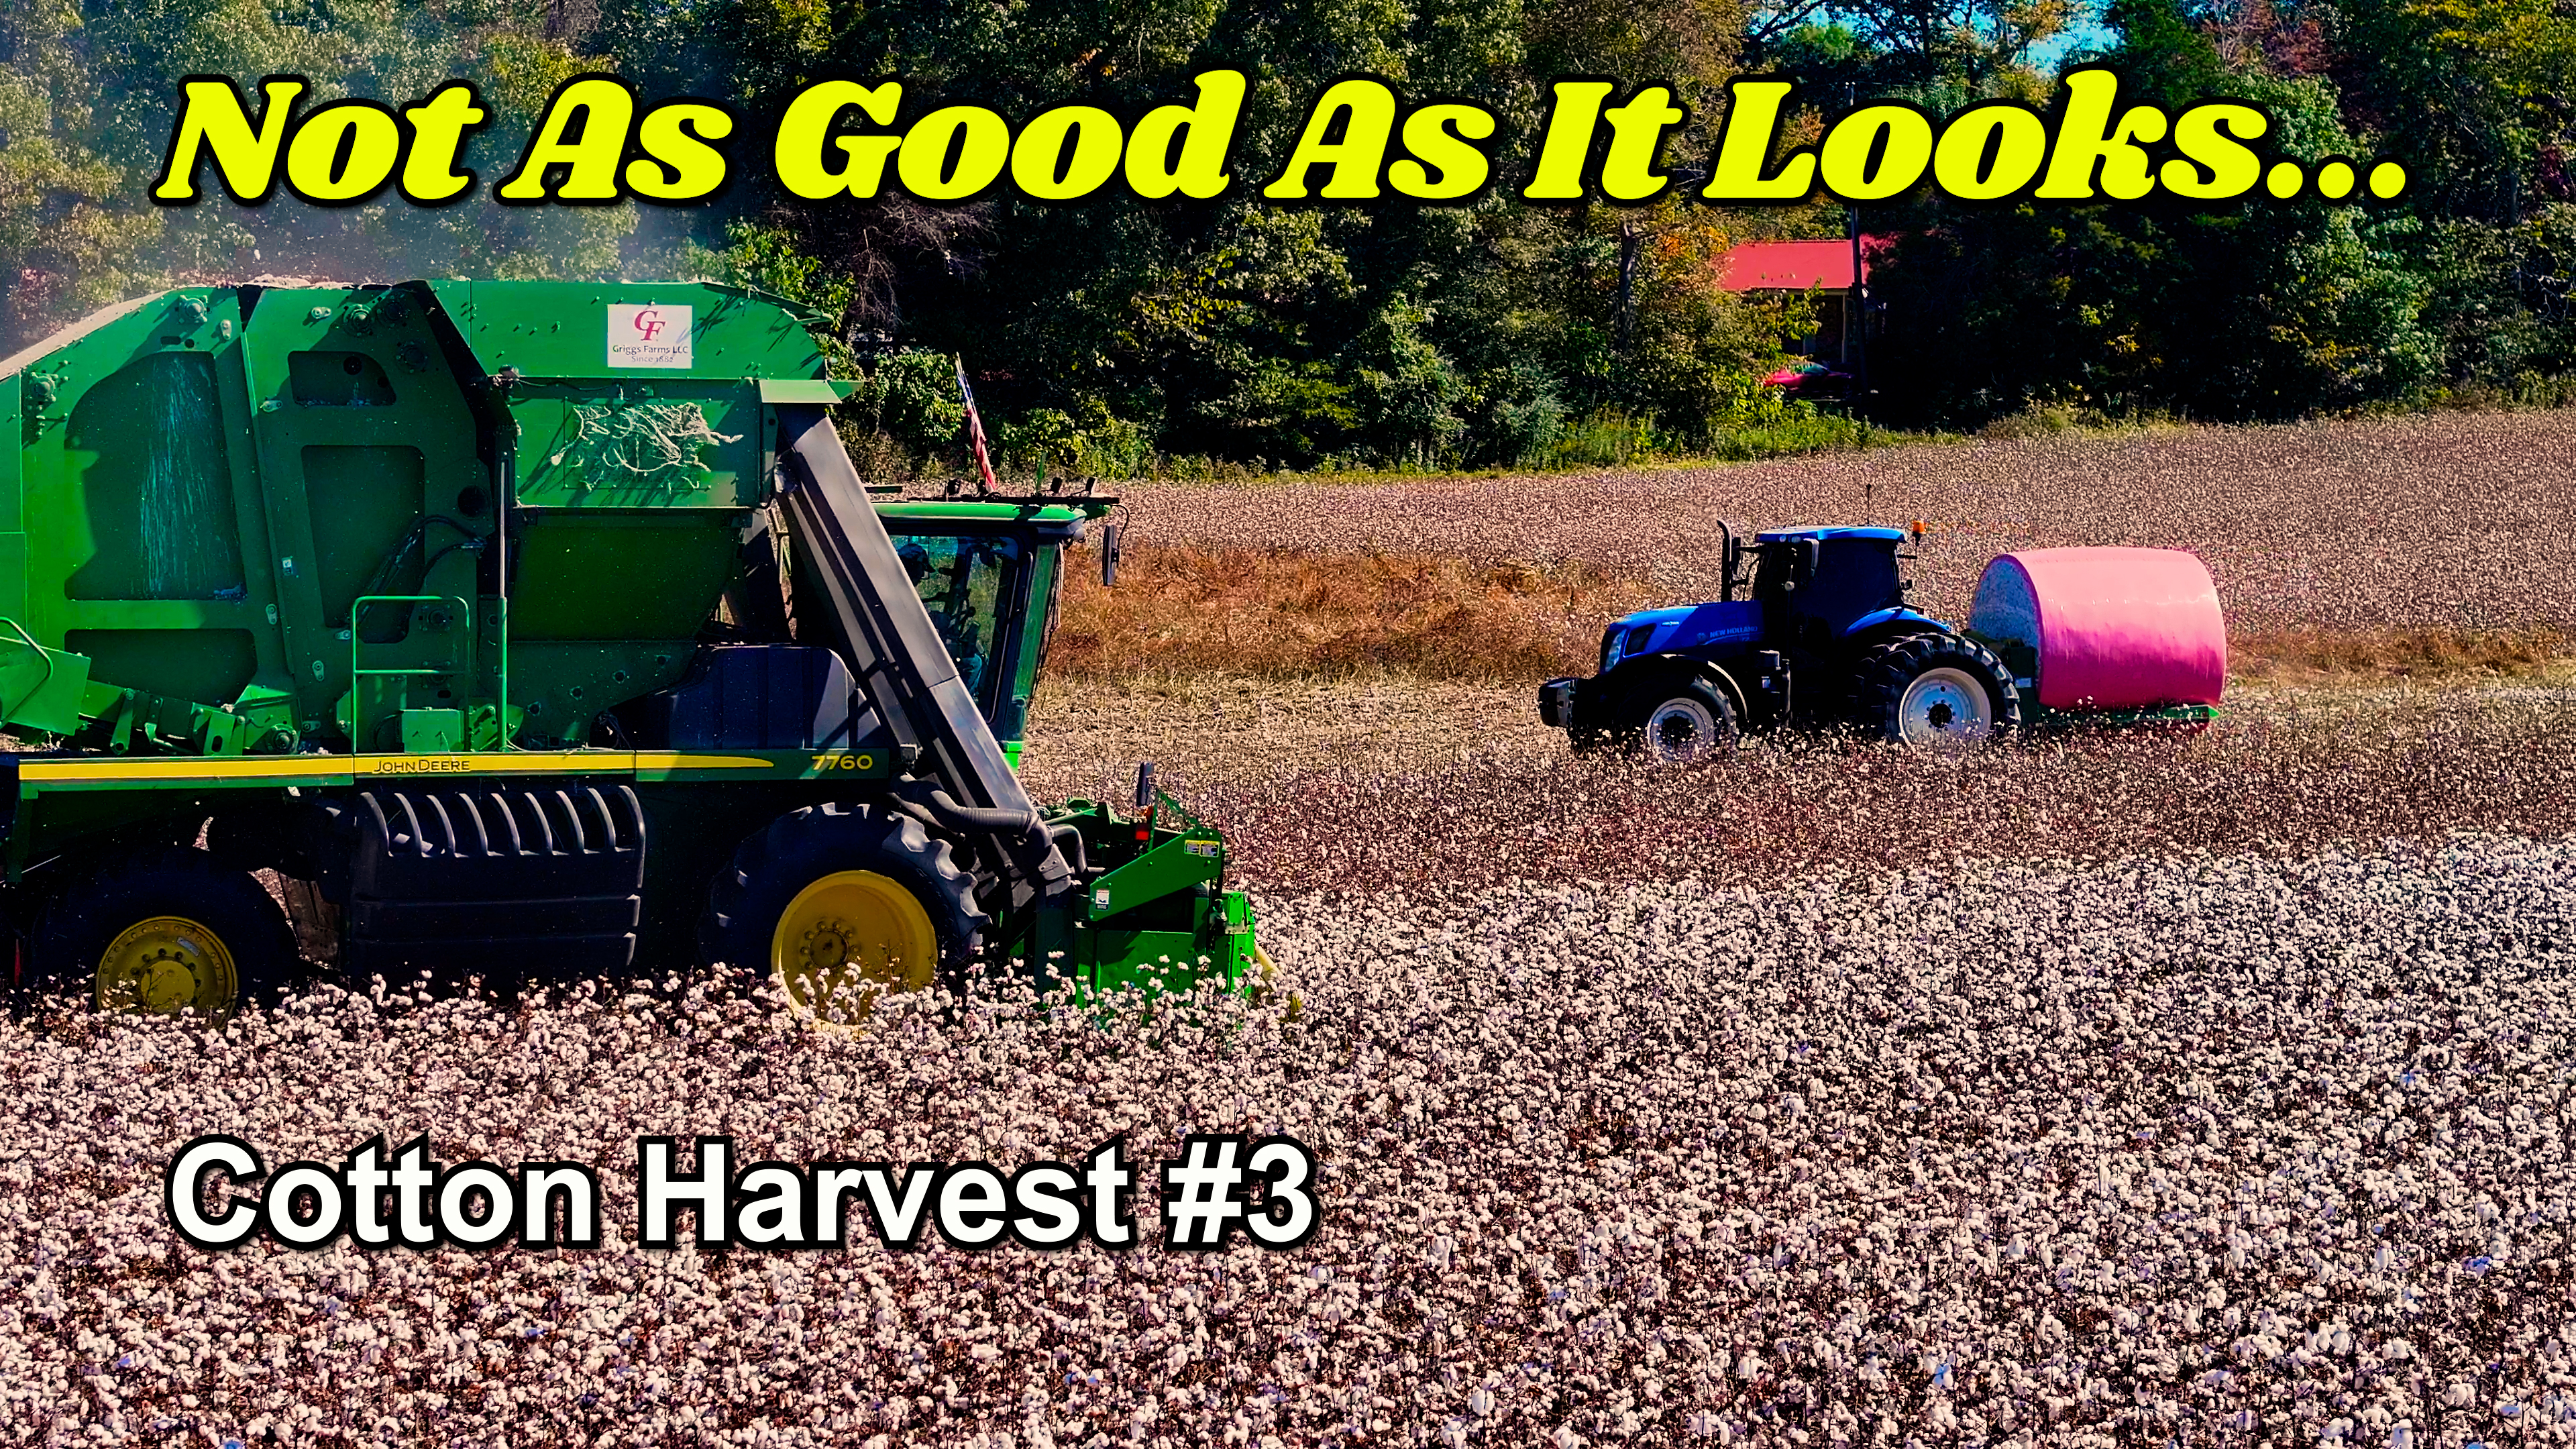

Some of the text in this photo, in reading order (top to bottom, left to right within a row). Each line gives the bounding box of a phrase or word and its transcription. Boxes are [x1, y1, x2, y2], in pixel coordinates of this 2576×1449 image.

[612, 345, 641, 356] Griggs
[643, 345, 670, 354] Farms
[1709, 629, 1726, 639] NEW
[373, 759, 470, 772] JOHN DEERE
[811, 754, 873, 770] 7760
